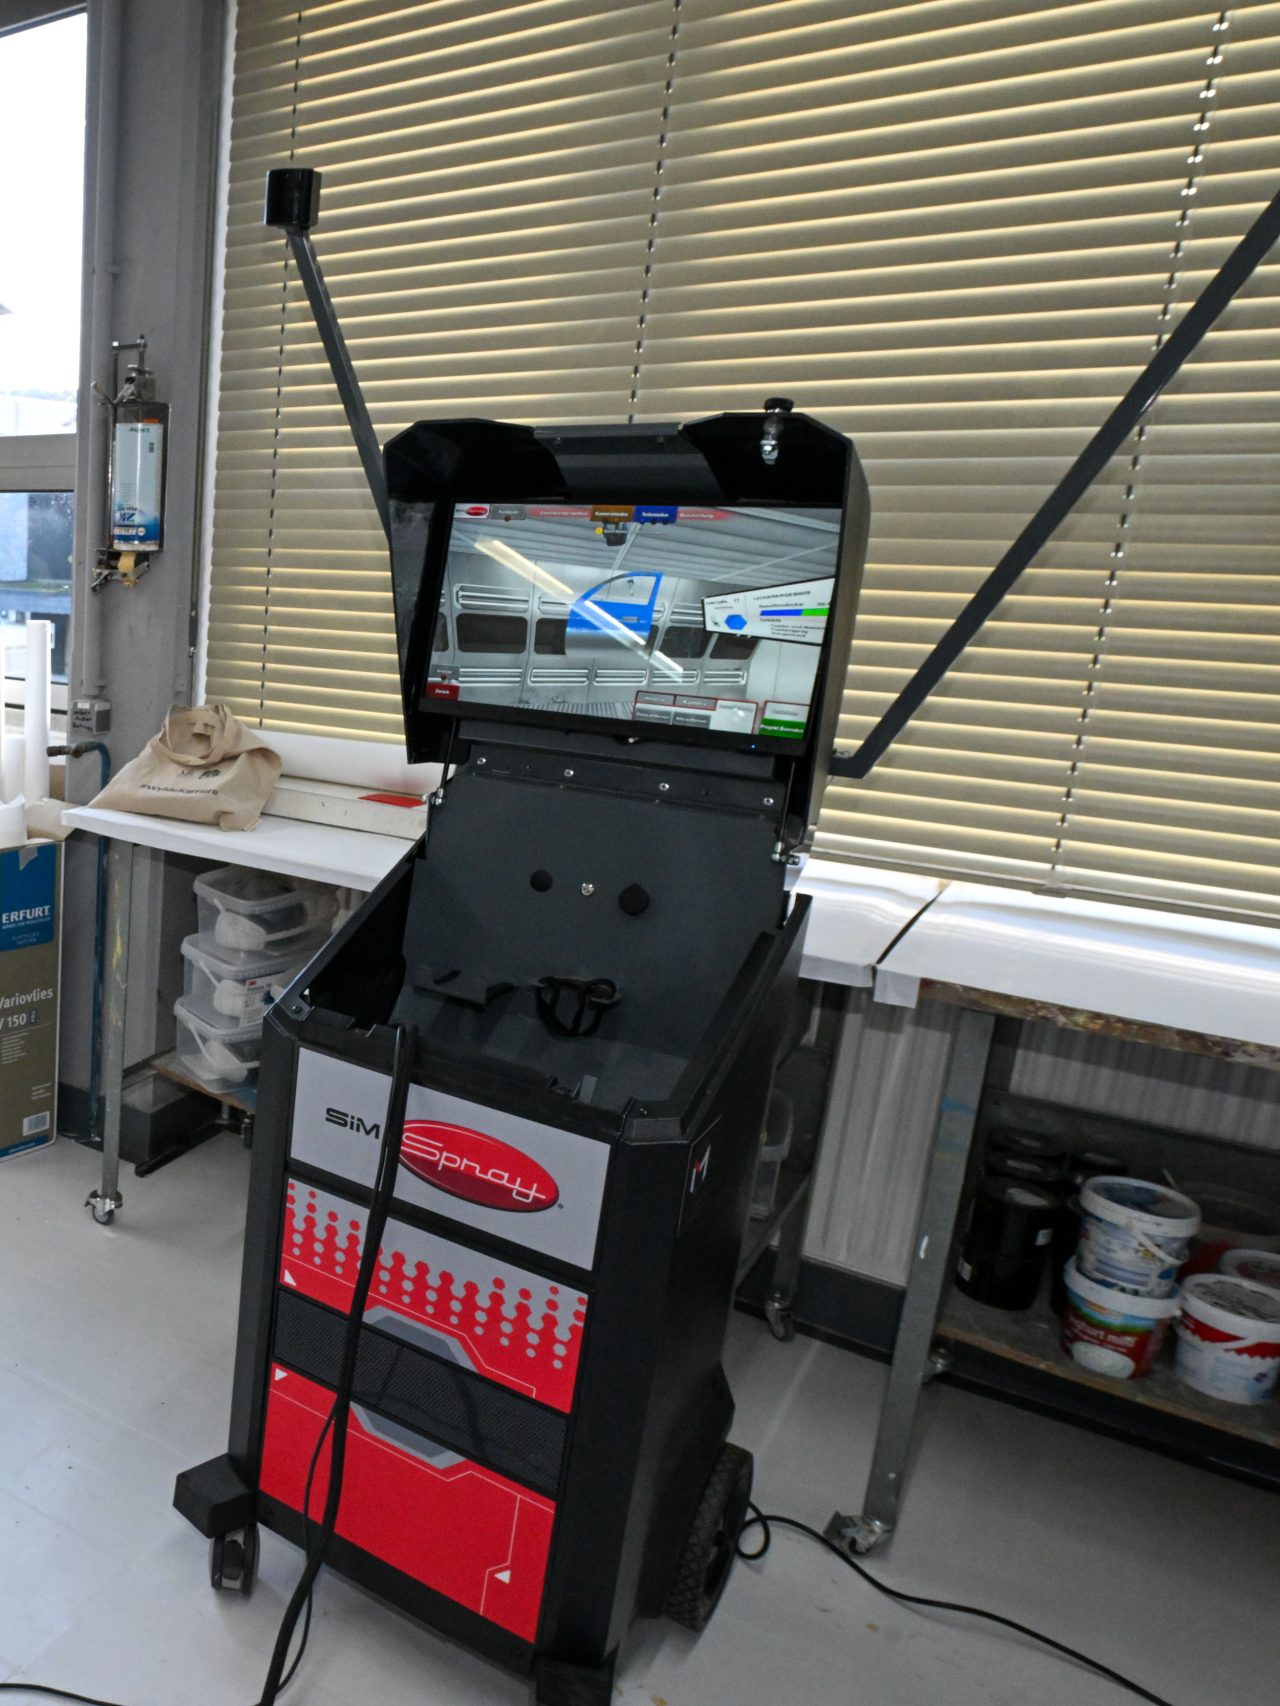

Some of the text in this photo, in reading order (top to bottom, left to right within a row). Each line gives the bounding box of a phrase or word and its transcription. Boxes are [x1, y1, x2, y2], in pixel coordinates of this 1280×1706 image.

[2, 905, 51, 924] ERFURT
[8, 1013, 27, 1028] 150
[401, 1132, 546, 1203] Spray
